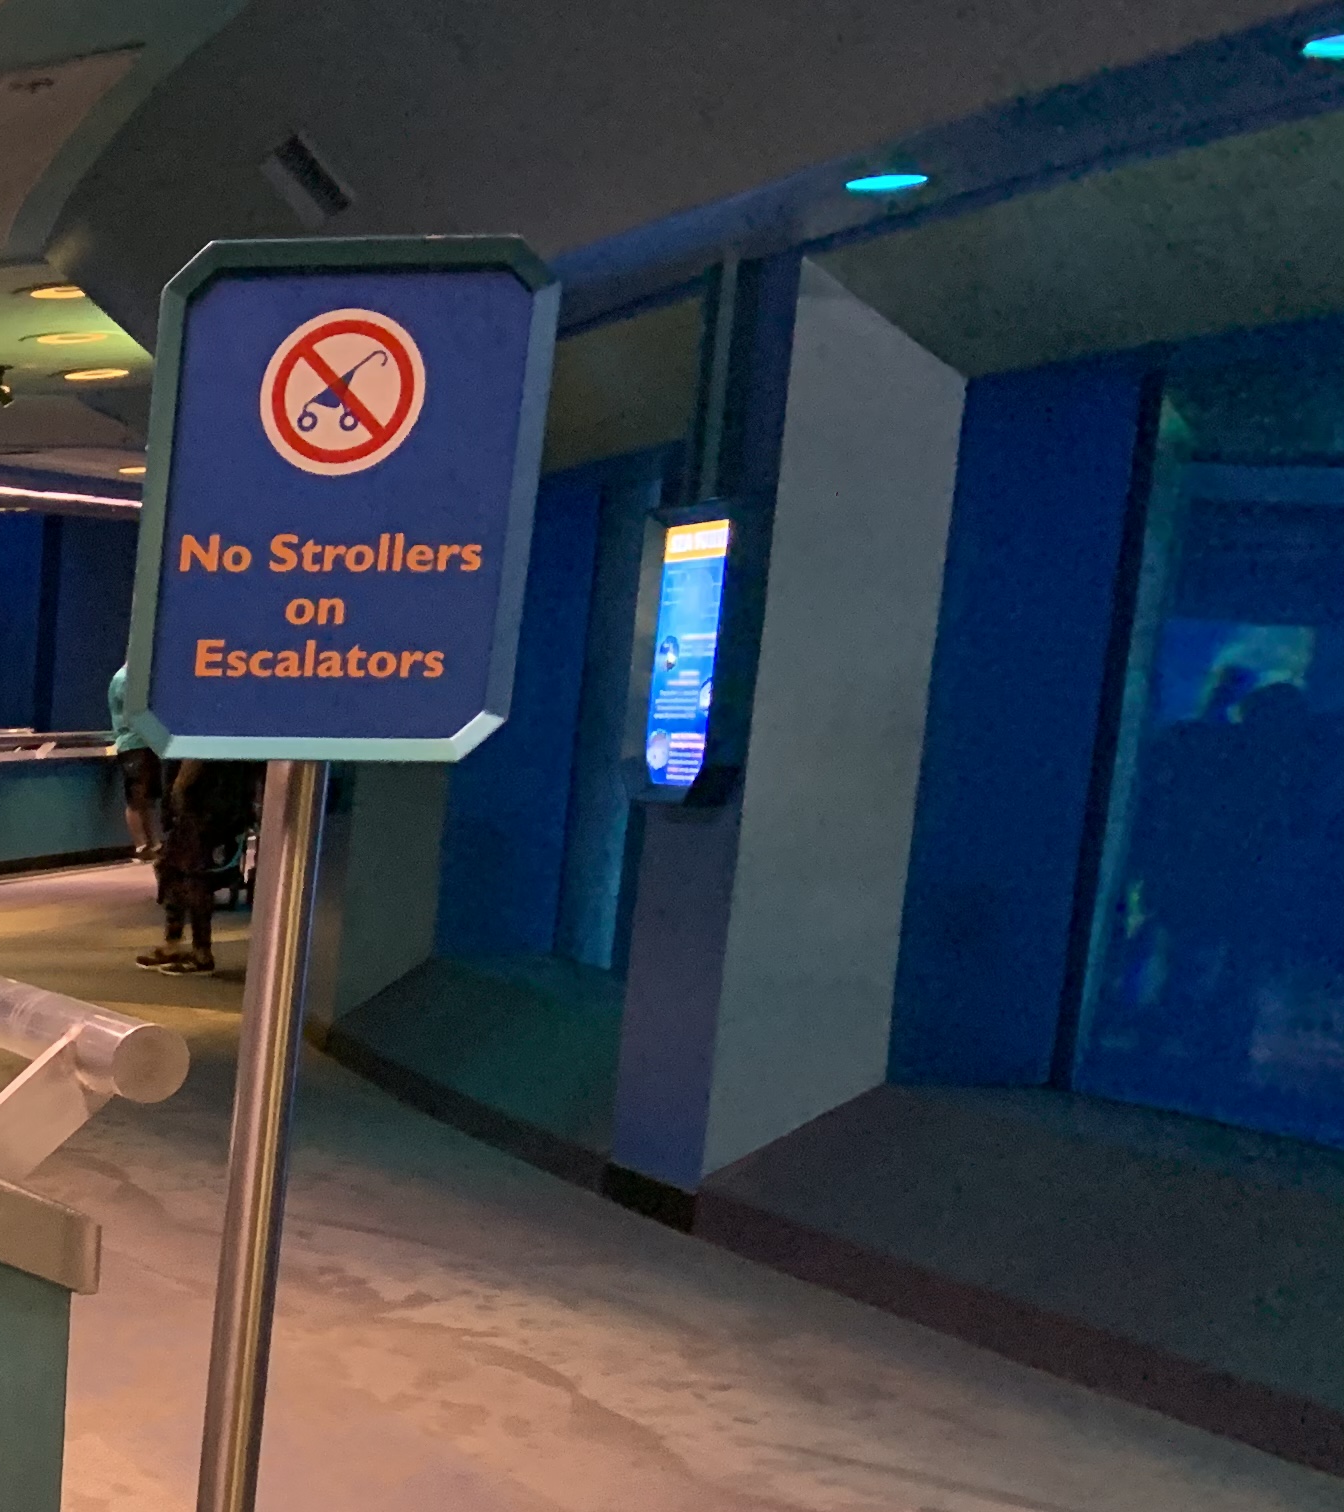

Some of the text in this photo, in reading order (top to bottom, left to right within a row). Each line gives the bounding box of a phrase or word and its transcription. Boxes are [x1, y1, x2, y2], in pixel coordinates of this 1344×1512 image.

[178, 532, 483, 573] No Strollers
[284, 597, 346, 626] on
[193, 638, 445, 679] Escalators
